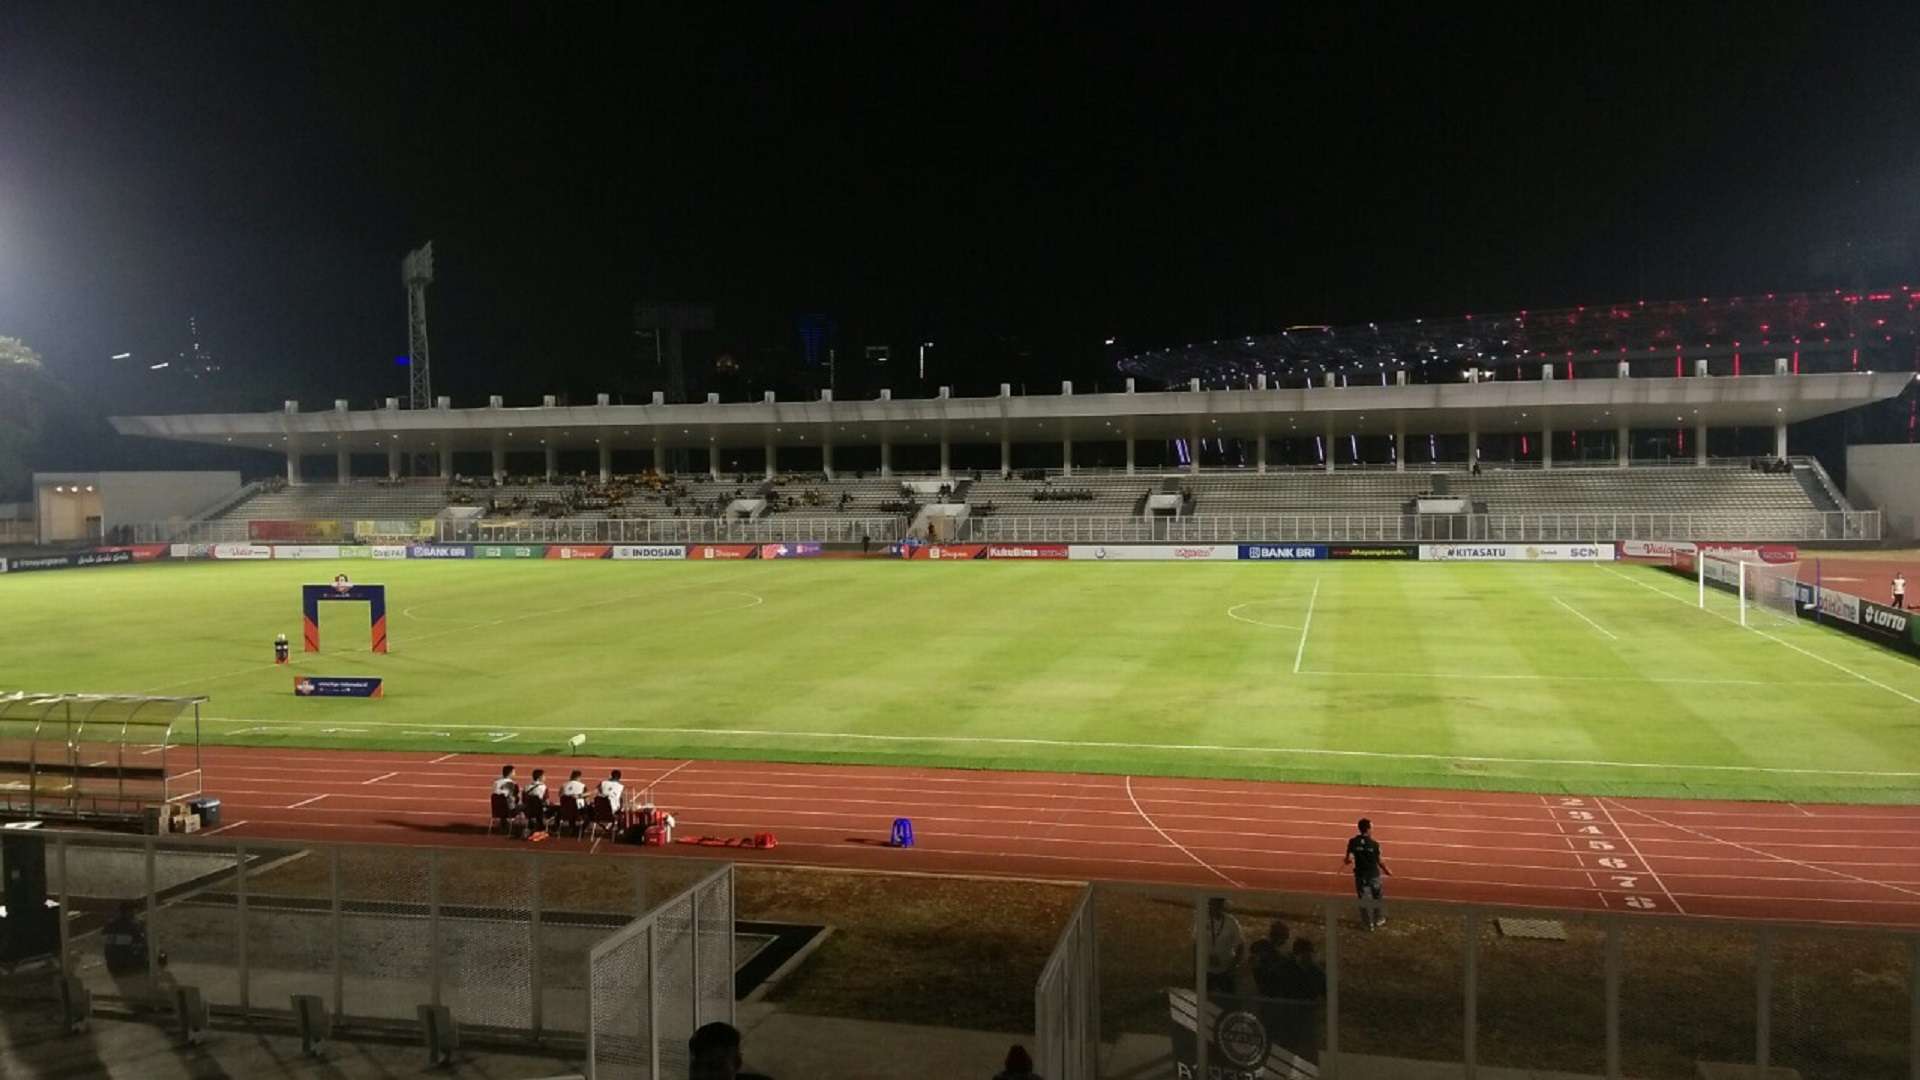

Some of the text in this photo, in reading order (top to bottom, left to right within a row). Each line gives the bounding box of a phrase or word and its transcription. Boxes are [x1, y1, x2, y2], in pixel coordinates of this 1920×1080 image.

[632, 548, 682, 557] INDOSIAR
[1261, 547, 1315, 558] BANK BRI
[1447, 547, 1507, 558] #KITASATU
[1569, 547, 1599, 558] SCM
[1873, 609, 1907, 632] LOTTO
[1597, 857, 1628, 869] 6
[1610, 875, 1639, 888] 7
